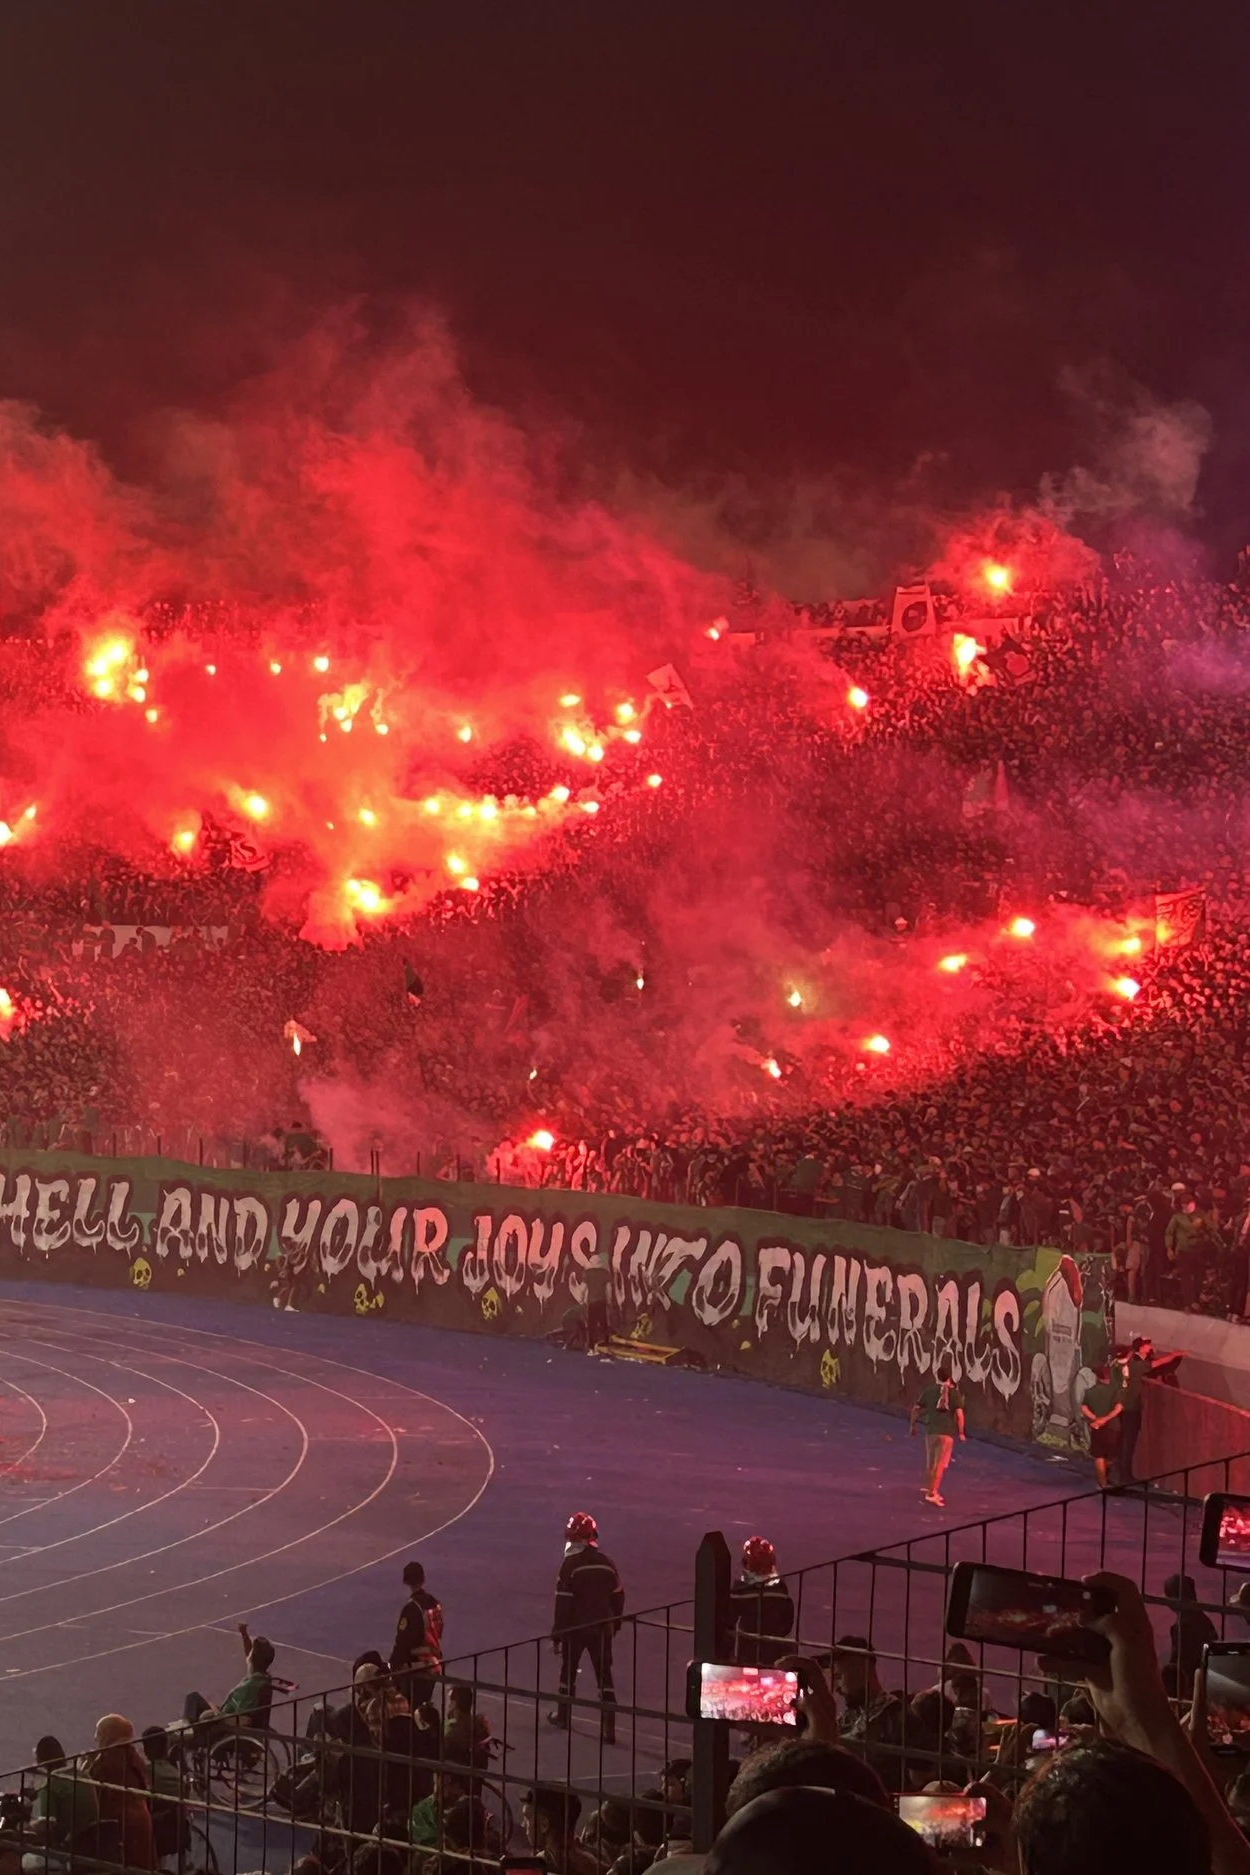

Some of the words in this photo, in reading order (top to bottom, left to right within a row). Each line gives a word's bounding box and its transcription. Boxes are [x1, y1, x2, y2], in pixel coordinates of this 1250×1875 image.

[154, 1187, 269, 1276] AND
[278, 1198, 450, 1293] YOUR
[462, 1214, 599, 1312] JOYS
[611, 1225, 742, 1327] INTO
[754, 1246, 1021, 1402] FUNERALS
